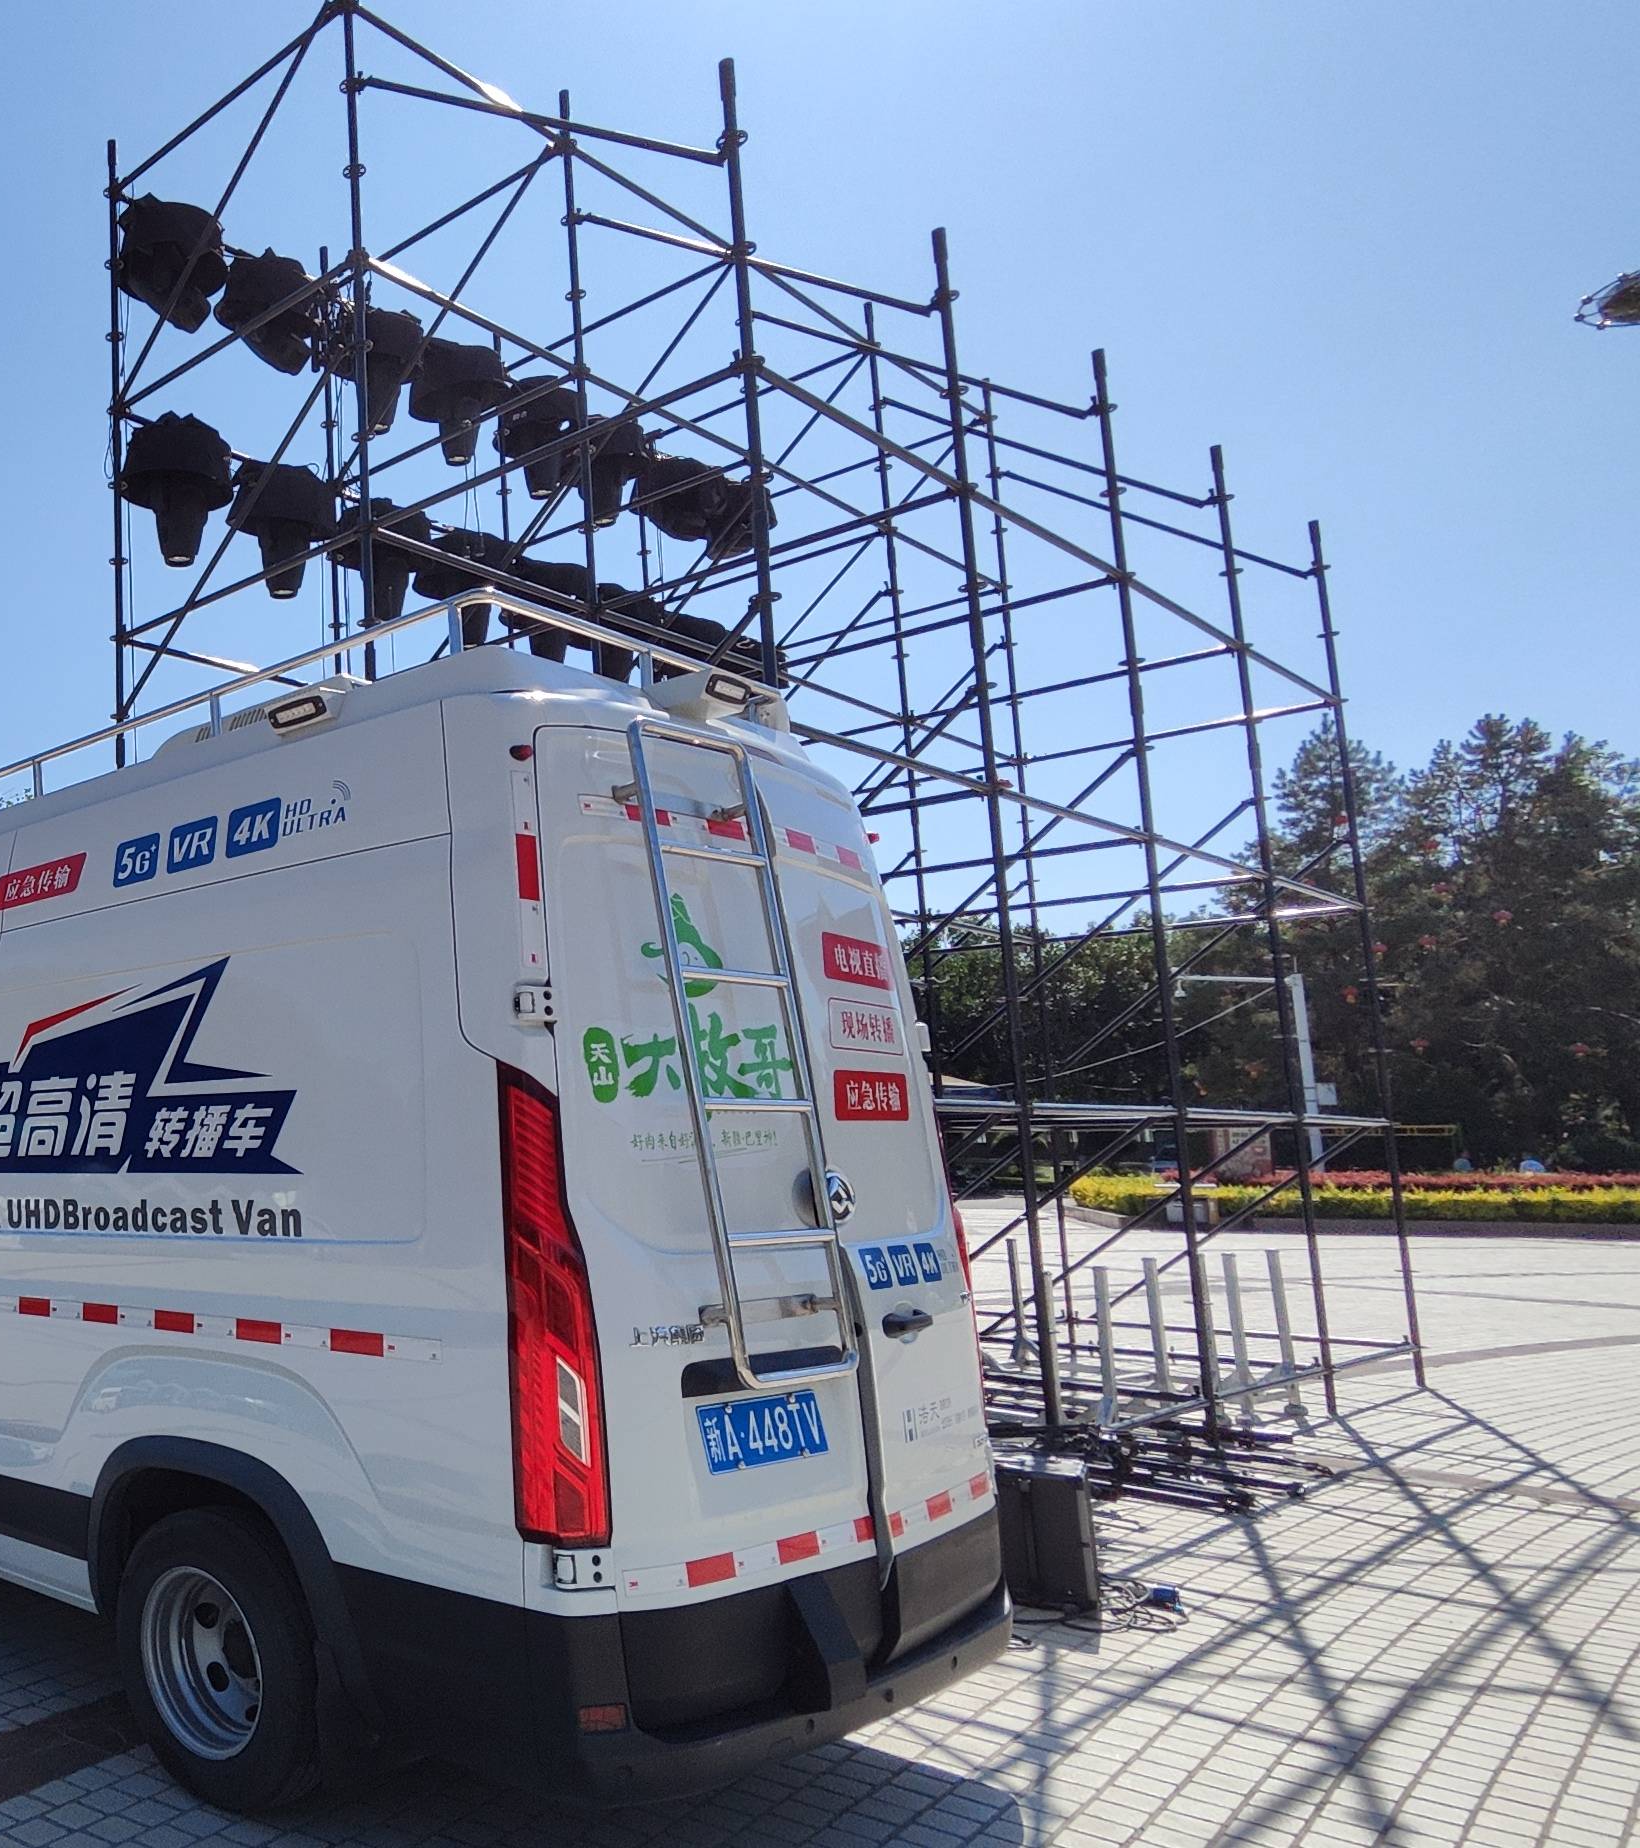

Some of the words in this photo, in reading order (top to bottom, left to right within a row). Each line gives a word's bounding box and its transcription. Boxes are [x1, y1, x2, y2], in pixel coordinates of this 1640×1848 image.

[282, 806, 348, 837] ULTRA
[284, 799, 312, 821] HD
[172, 827, 214, 862] VR
[231, 808, 275, 846] 4K
[3, 864, 73, 904] 应急传输
[833, 943, 890, 982] 电视直播
[840, 1010, 896, 1045] 现场转播
[589, 1042, 615, 1087] 天山
[845, 1079, 902, 1112] 应急传输
[143, 1103, 275, 1159] 转播车
[231, 1199, 303, 1238] Van
[891, 1253, 916, 1278] VR
[921, 1251, 939, 1275] 4K
